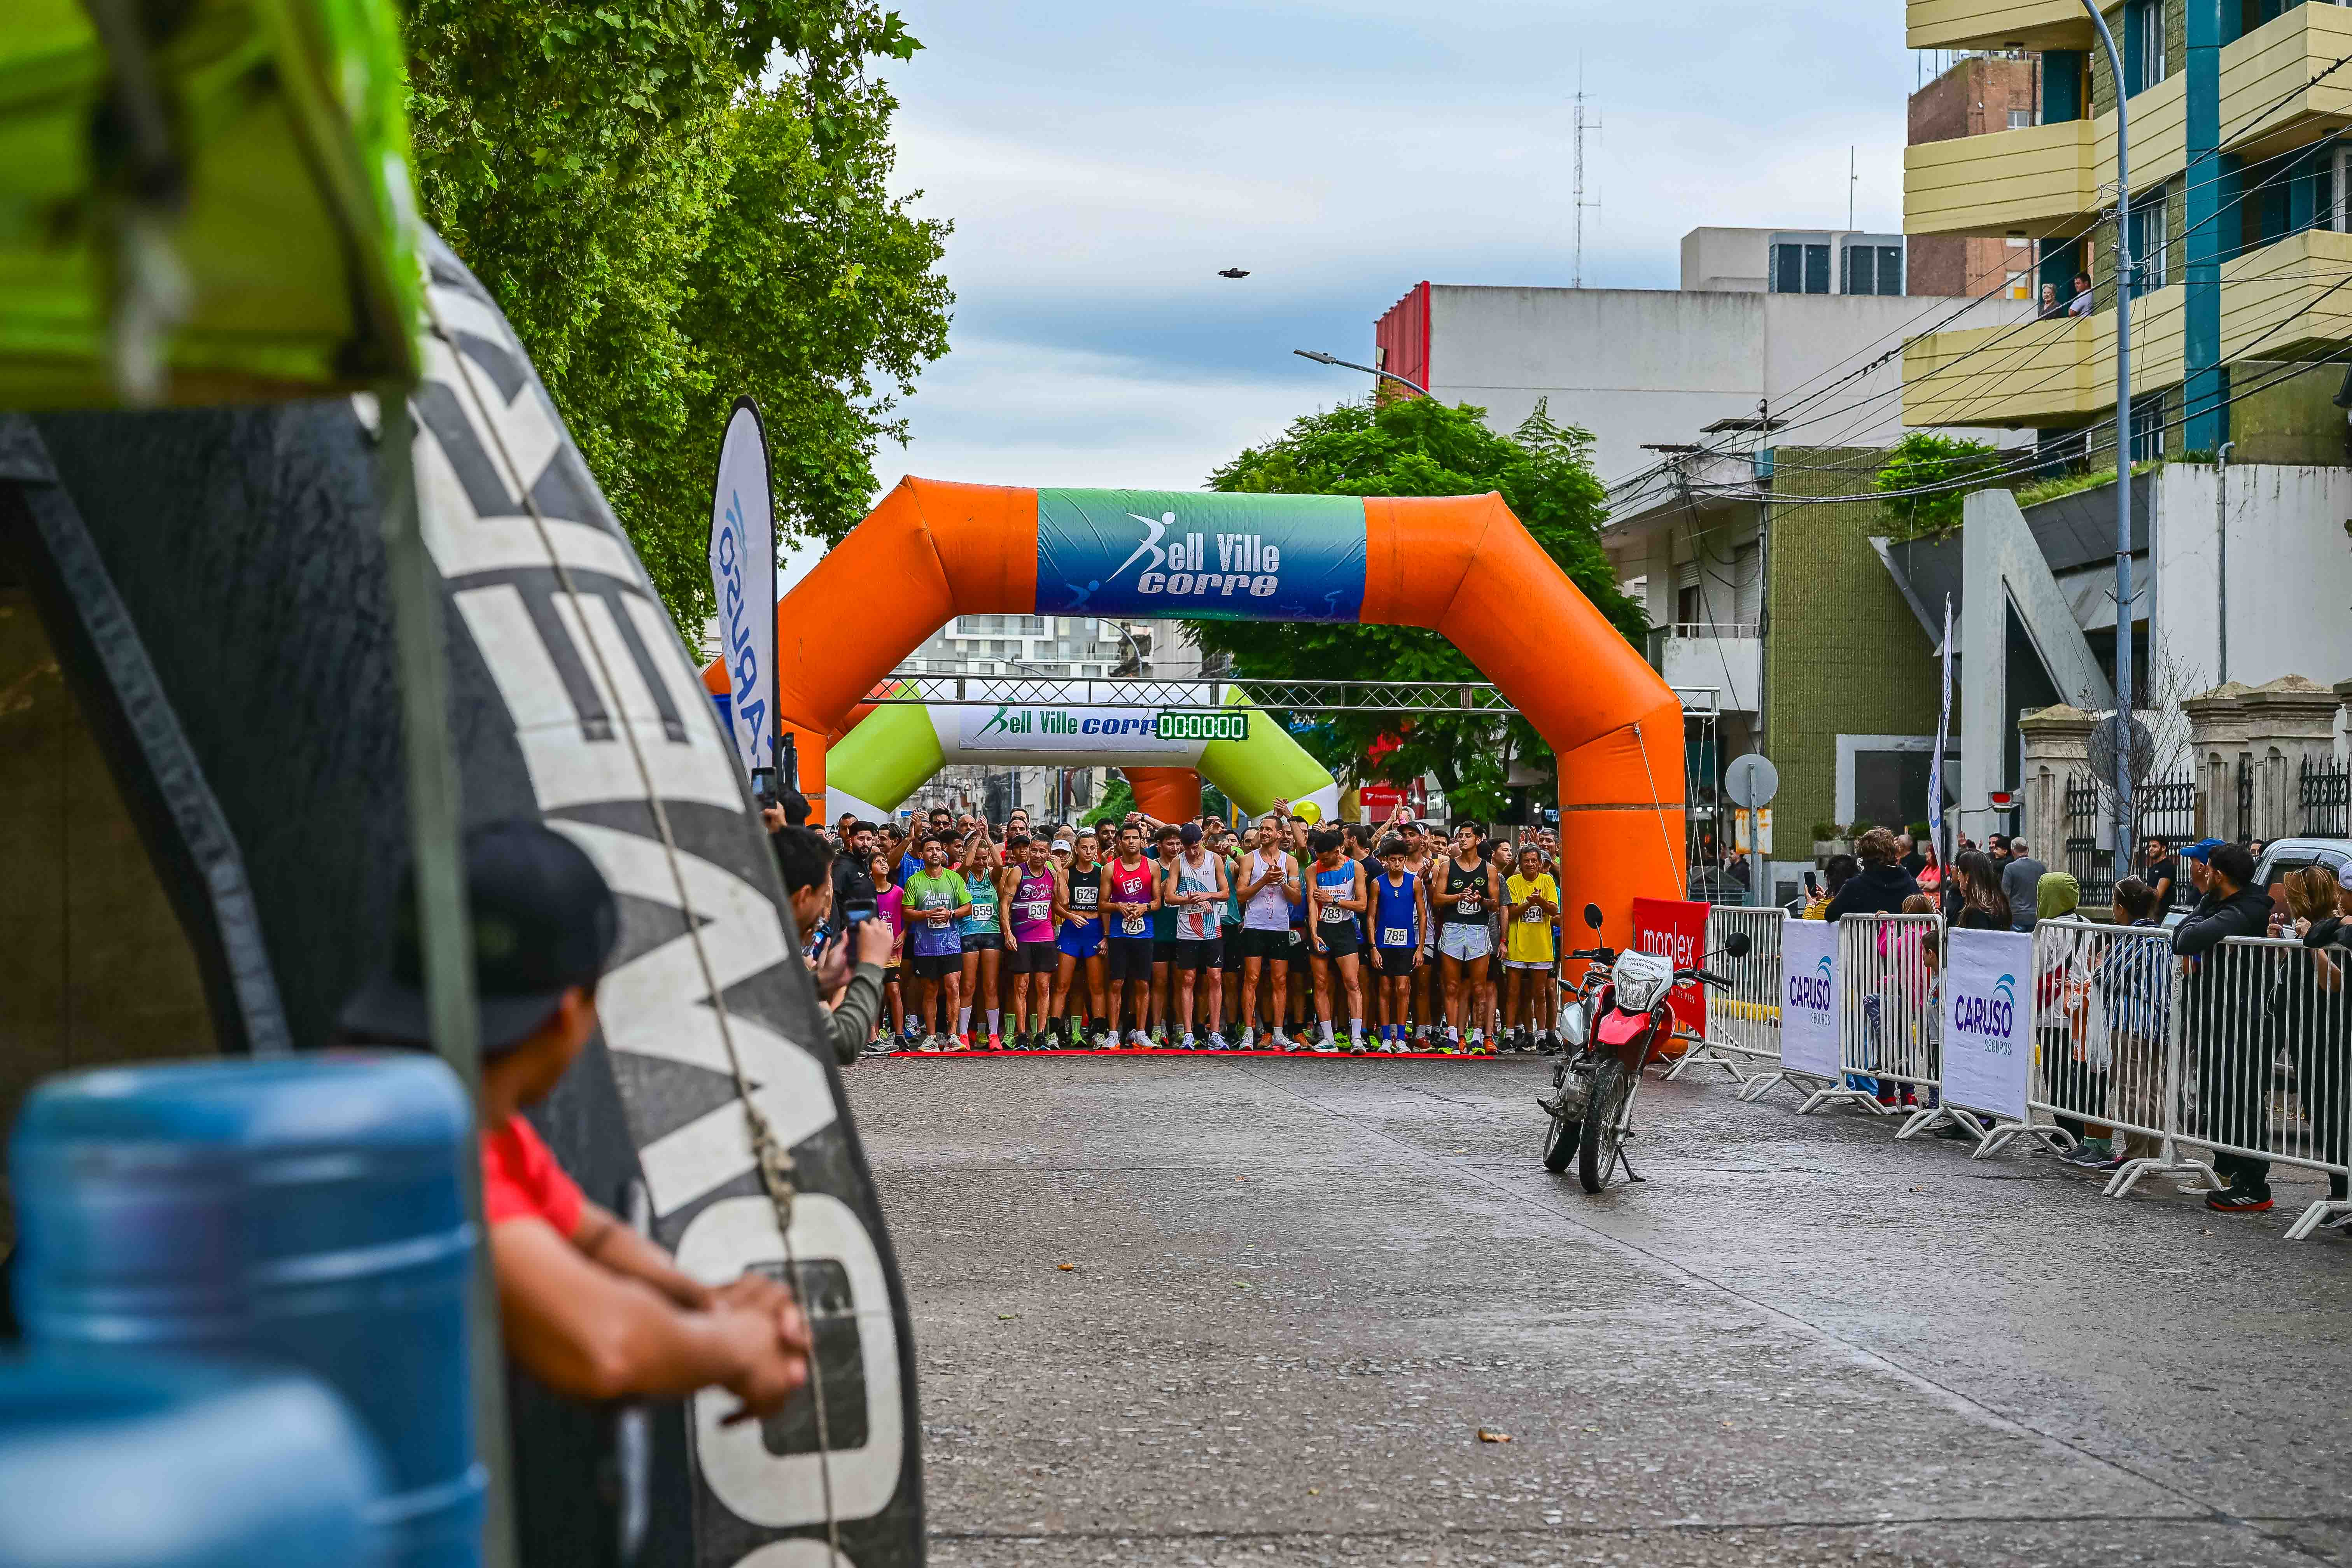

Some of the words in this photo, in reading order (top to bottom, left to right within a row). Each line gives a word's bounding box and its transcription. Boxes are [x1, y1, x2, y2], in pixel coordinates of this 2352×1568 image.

[1216, 533, 1279, 573] Ville
[1138, 572, 1278, 597] corre
[1040, 711, 1078, 735] Ville
[1081, 718, 1157, 735] corr
[1160, 716, 1244, 738] 00:00:00
[1077, 888, 1097, 900] 625
[412, 249, 902, 1568] OWER
[973, 905, 992, 916] 659
[1030, 905, 1048, 916] 636
[1322, 907, 1340, 919] 783
[1124, 919, 1143, 931] 726
[1386, 930, 1405, 941] 785
[1626, 957, 1663, 970] ORGANIZACION
[1630, 962, 1655, 971] MARATON
[1685, 992, 1694, 1004] PIES
[1790, 975, 1830, 1012] CARUSO
[1811, 1012, 1830, 1026] SEGUROS
[1955, 995, 2012, 1038] CARUSO
[1984, 1039, 2011, 1055] SEGUROS
